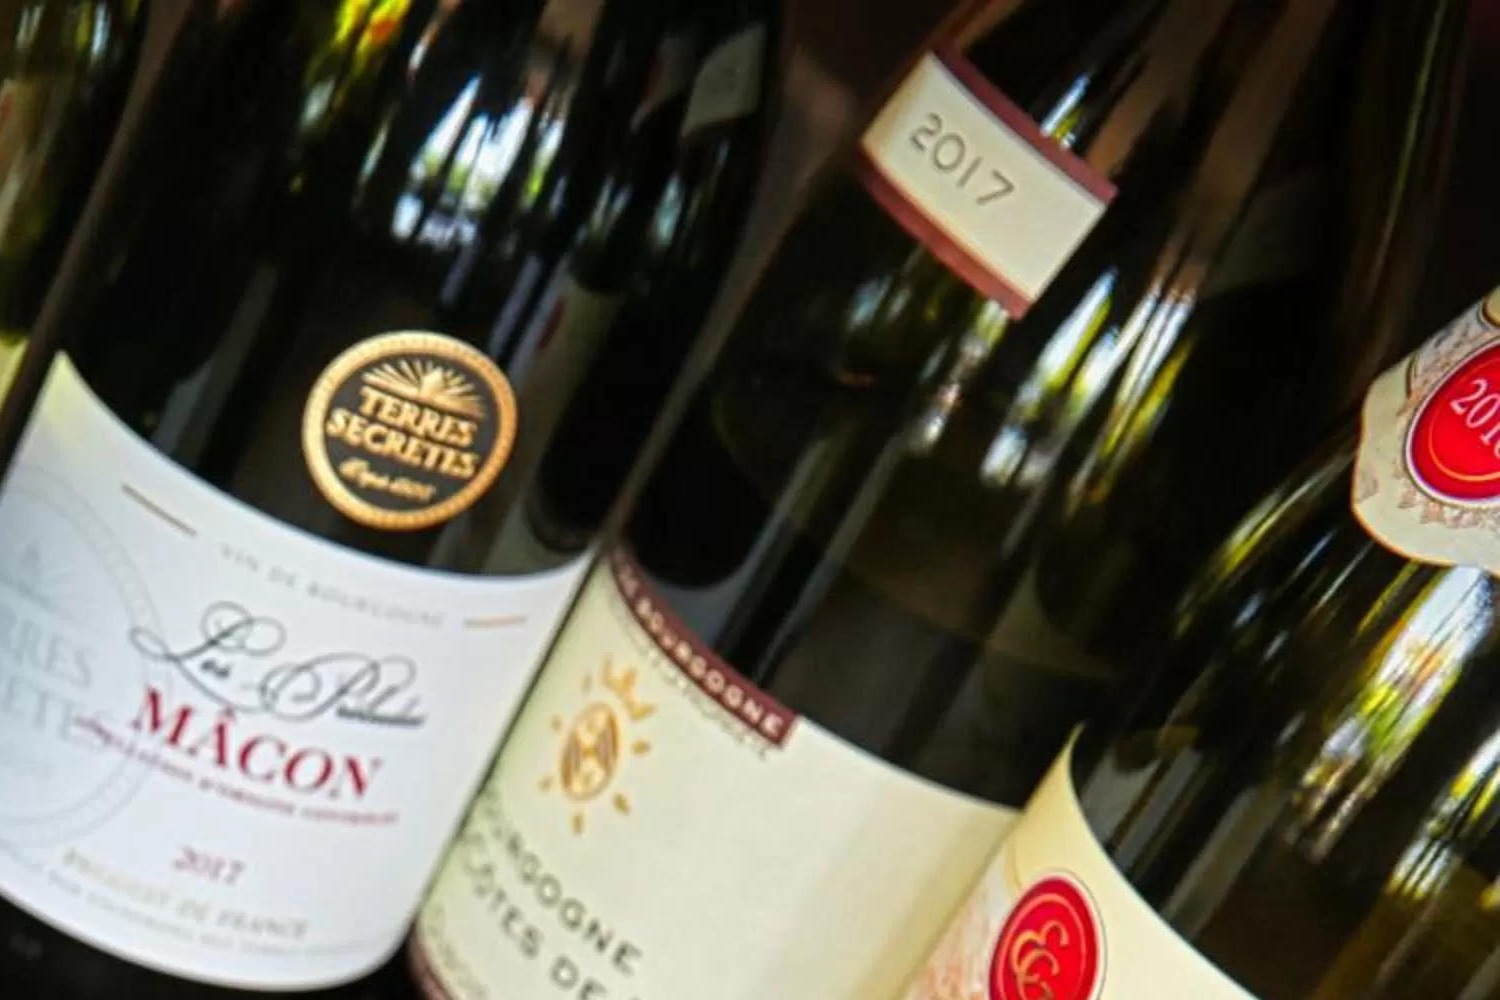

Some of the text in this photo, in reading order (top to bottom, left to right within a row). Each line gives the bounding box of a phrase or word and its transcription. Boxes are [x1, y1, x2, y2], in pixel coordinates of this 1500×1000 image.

[910, 111, 1016, 206] 2017
[359, 385, 477, 447] TERRES
[130, 685, 384, 799] MÂCON
